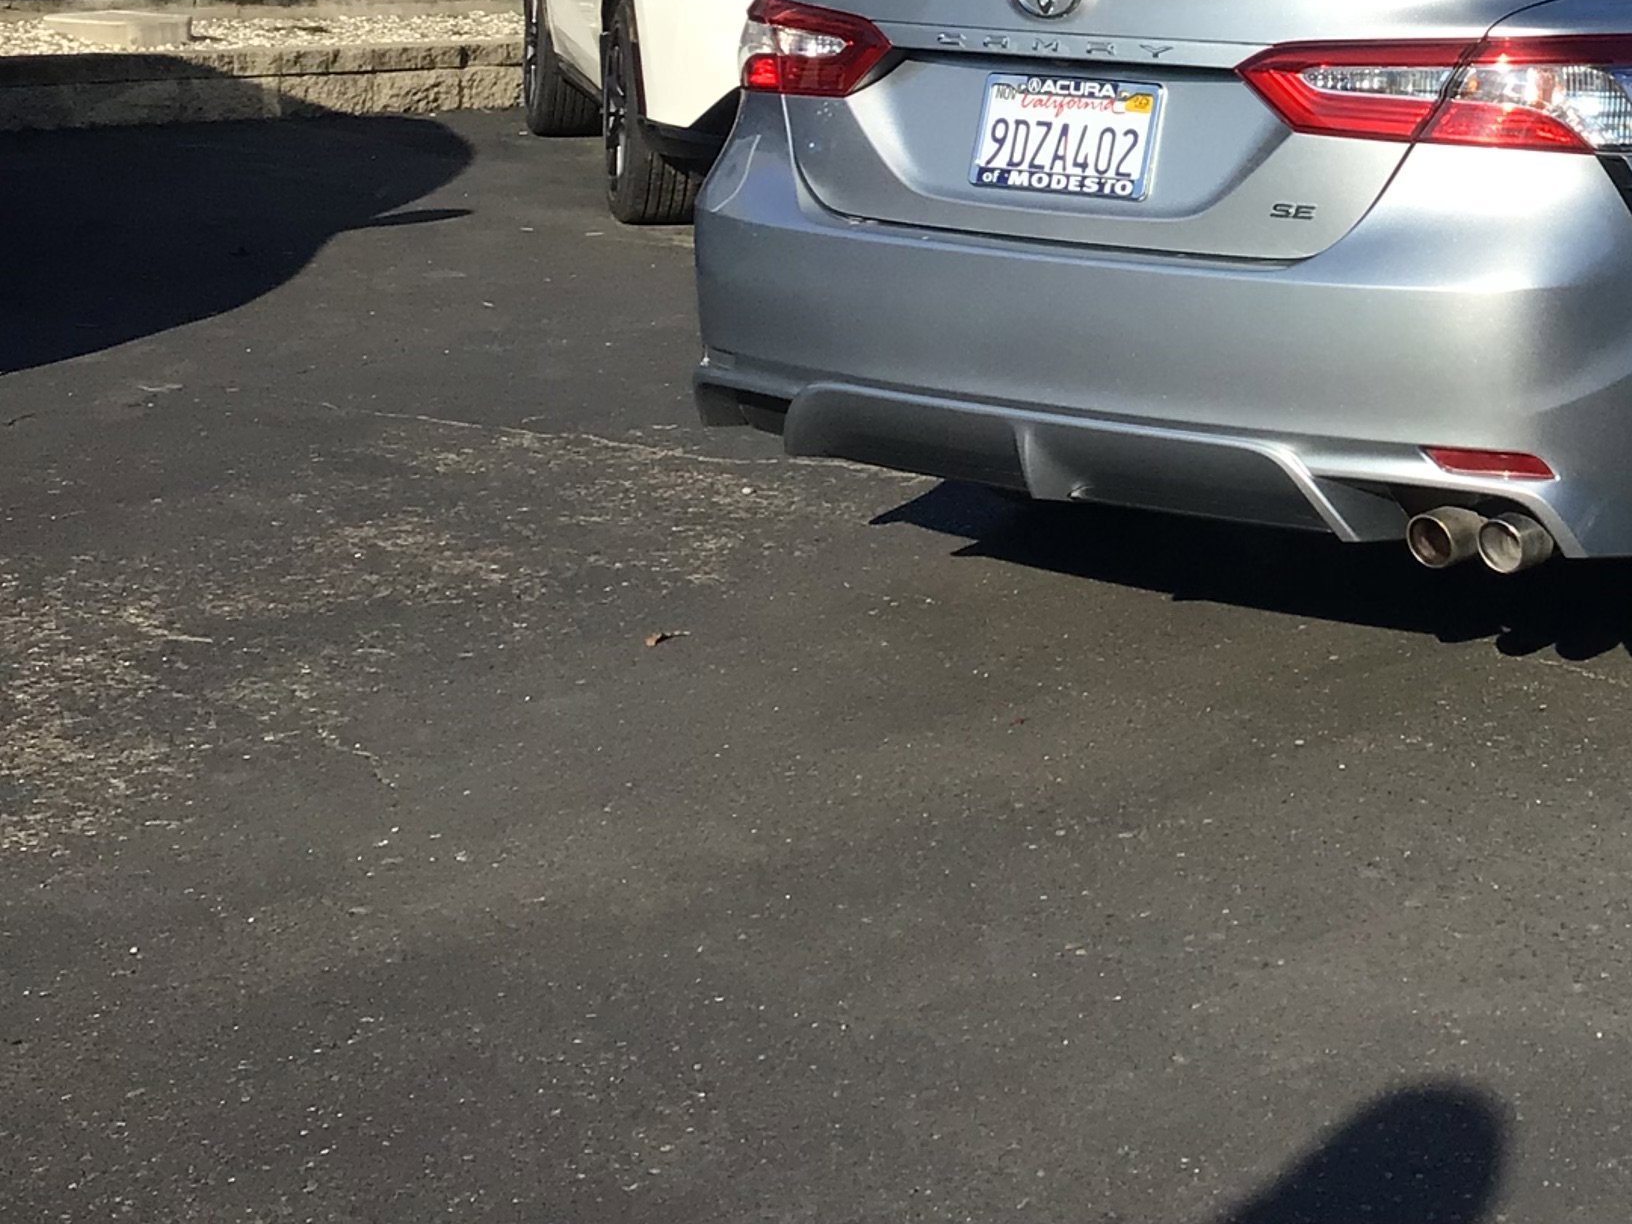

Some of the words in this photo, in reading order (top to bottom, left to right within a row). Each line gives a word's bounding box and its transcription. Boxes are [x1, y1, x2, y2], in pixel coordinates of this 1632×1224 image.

[937, 32, 1174, 58] CAMRY
[1040, 79, 1116, 98] ACURA
[1020, 92, 1125, 118] California
[985, 118, 1140, 178] 9DZA402
[982, 170, 1001, 183] of
[1007, 171, 1134, 195] MODESTO
[1269, 203, 1317, 221] SE
